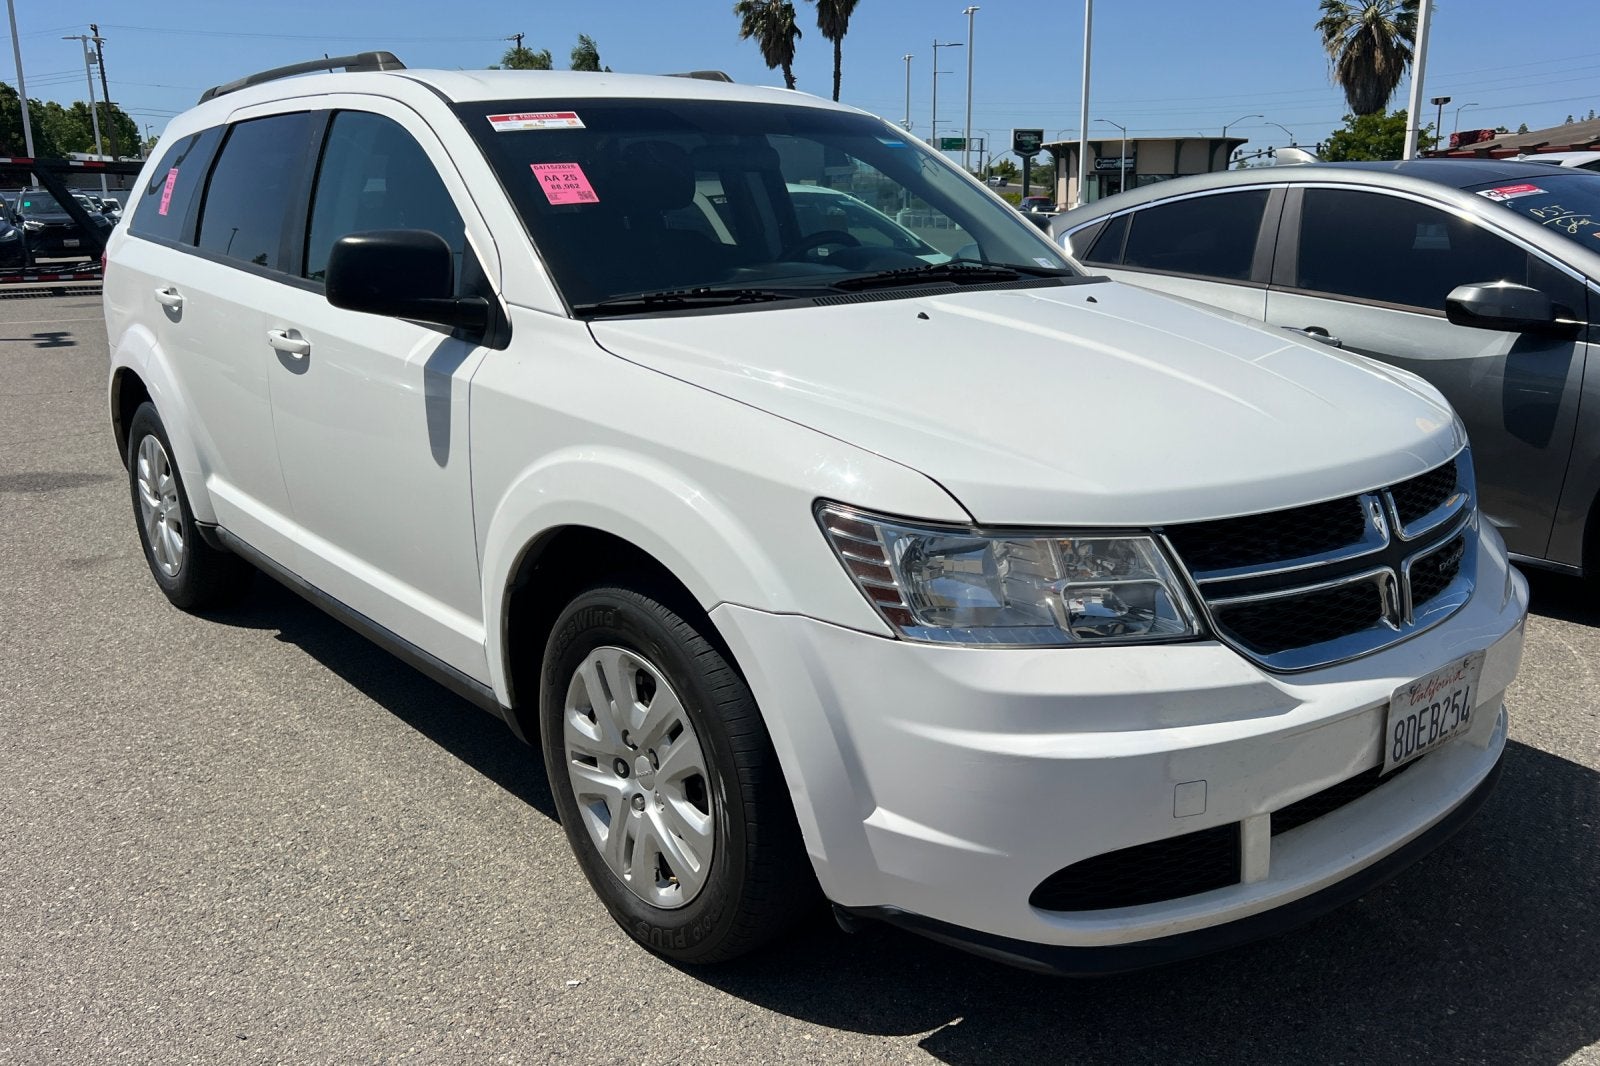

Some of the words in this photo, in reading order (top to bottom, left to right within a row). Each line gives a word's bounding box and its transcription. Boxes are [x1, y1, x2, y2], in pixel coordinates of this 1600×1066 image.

[544, 174, 561, 182] AA
[1410, 670, 1466, 706] California
[1392, 685, 1471, 763] 8DEB254
[635, 920, 688, 948] PLUS
